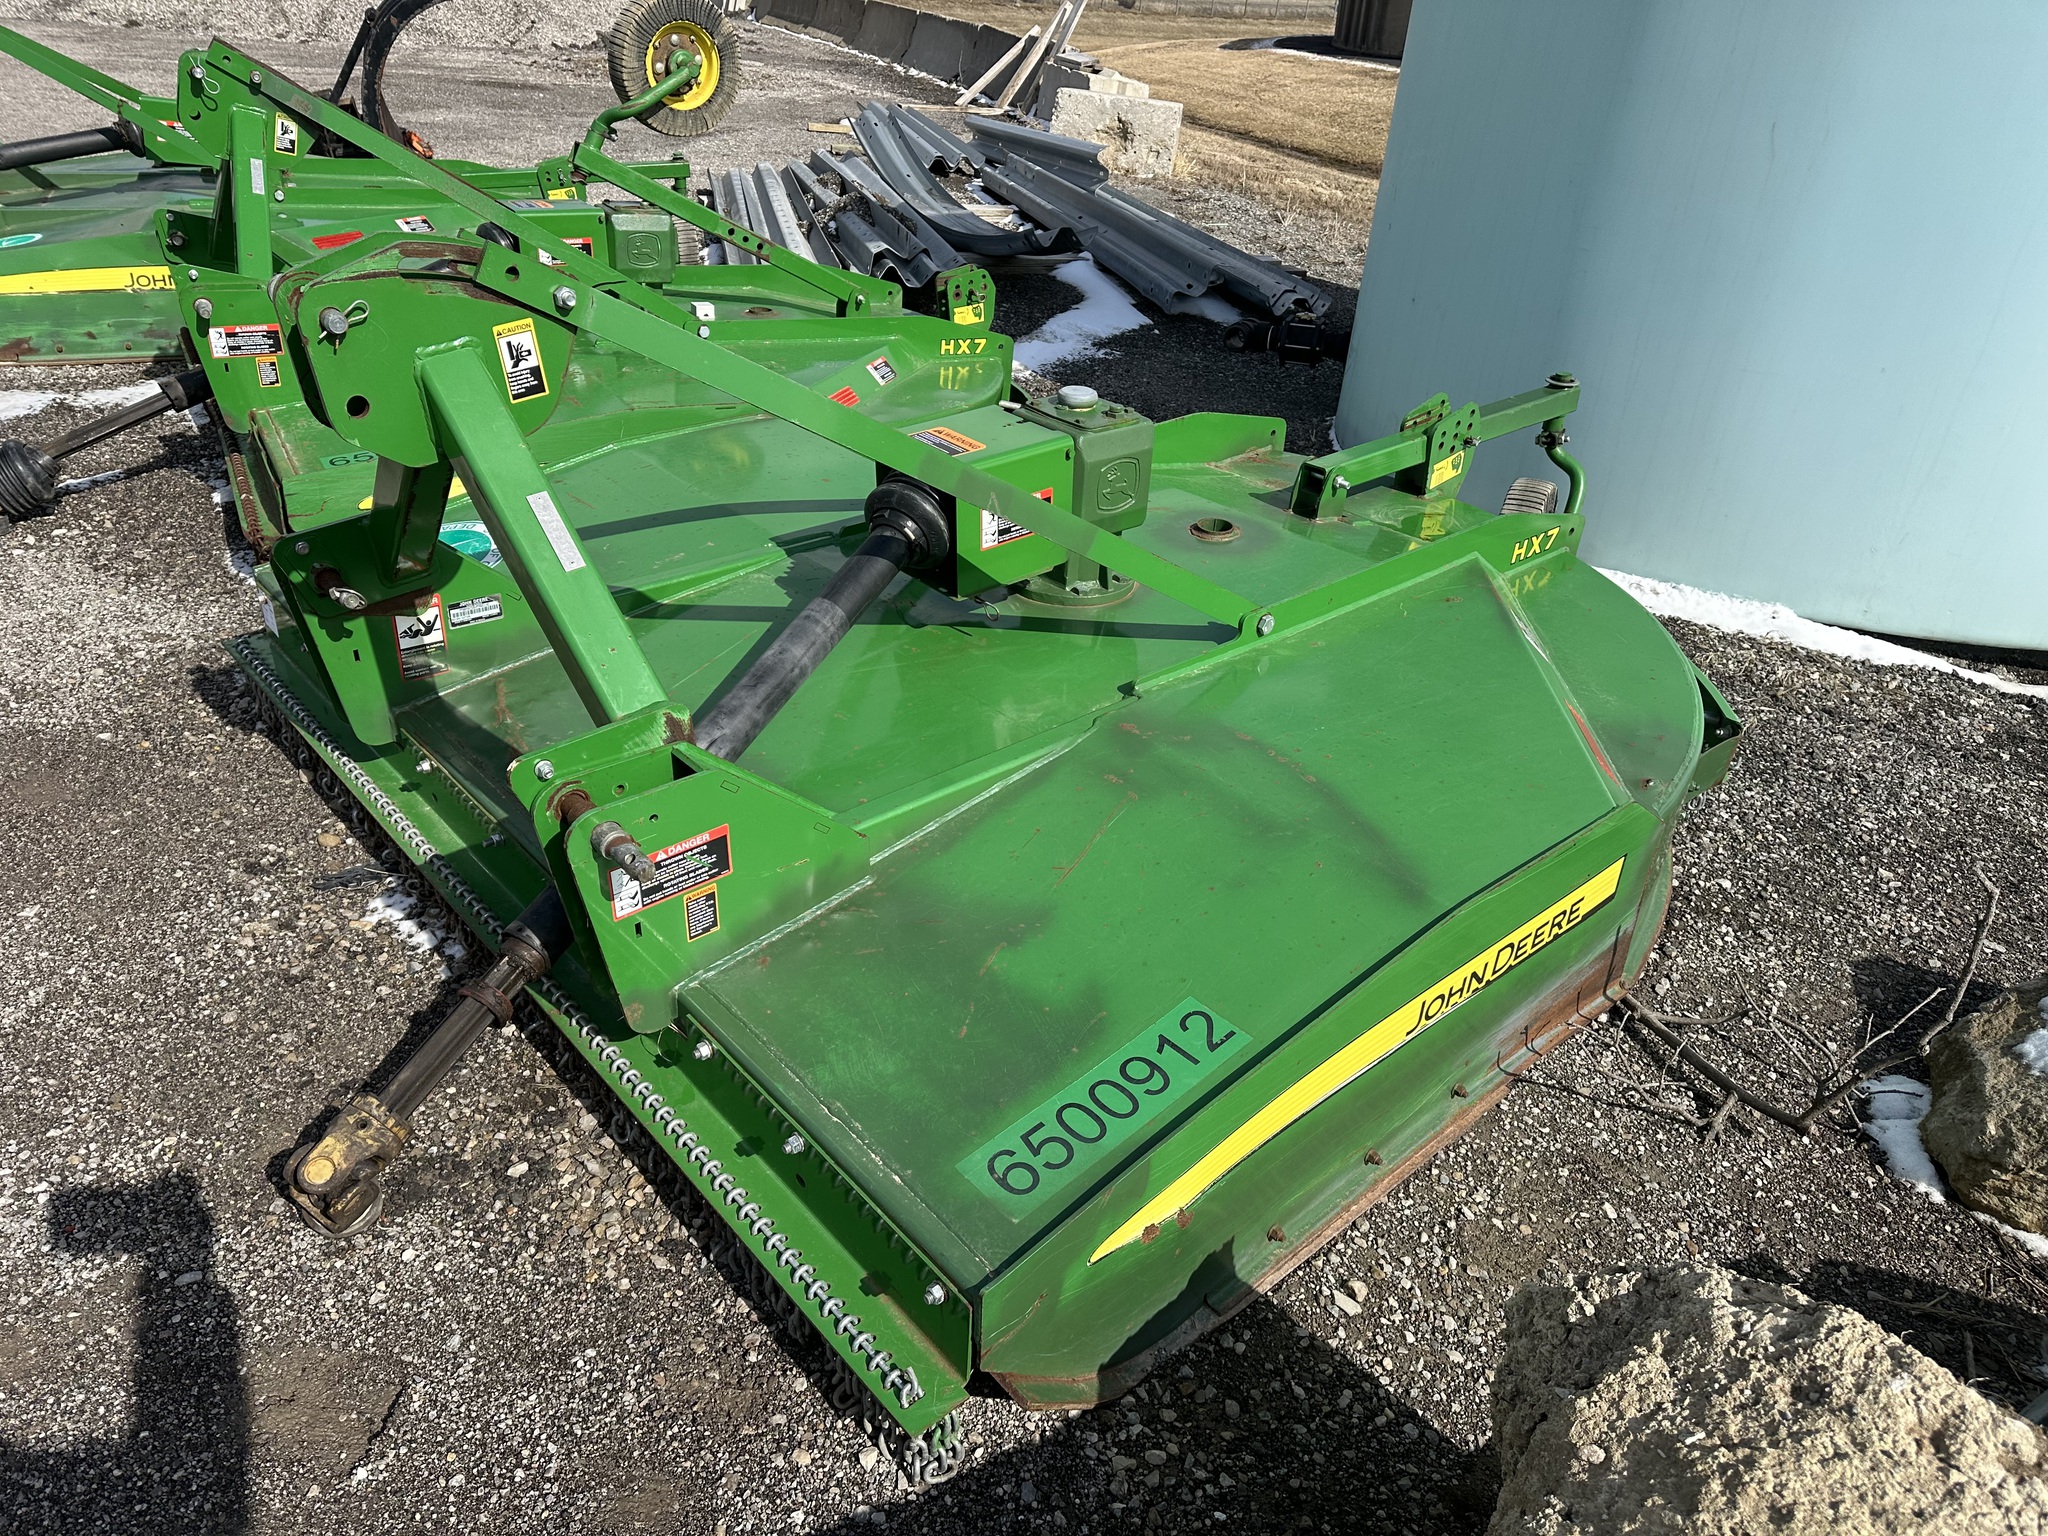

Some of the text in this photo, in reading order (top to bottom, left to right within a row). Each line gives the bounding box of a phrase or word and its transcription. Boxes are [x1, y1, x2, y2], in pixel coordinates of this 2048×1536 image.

[501, 322, 532, 335] CAUTION
[939, 338, 987, 355] HX7
[1510, 525, 1561, 565] HX7
[667, 833, 710, 856] DANGER
[691, 885, 716, 898] WARNING
[1405, 896, 1586, 1036] JOHN DEERE
[986, 1010, 1237, 1195] 6500912
